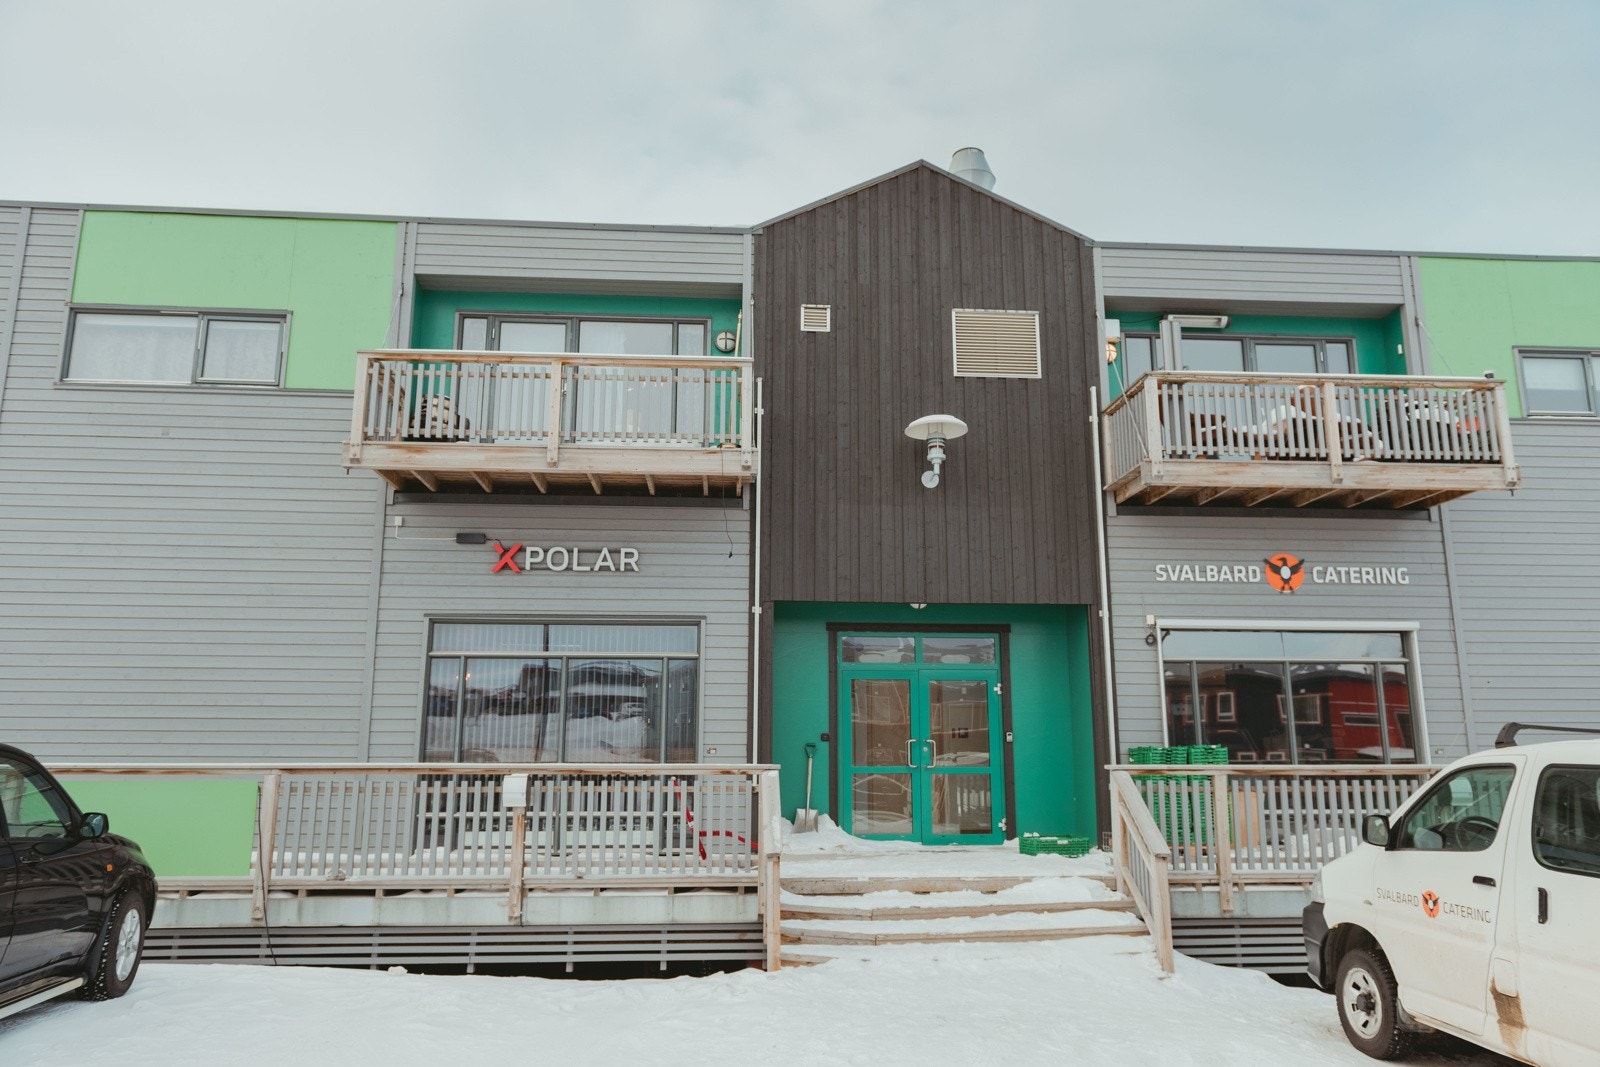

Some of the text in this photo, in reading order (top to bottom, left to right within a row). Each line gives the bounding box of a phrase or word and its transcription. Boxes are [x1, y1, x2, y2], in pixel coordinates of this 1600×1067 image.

[491, 543, 640, 574] XPOLAR
[1155, 564, 1410, 585] SVALBARD CATERING
[1376, 887, 1491, 924] SVALBARD CATERING
